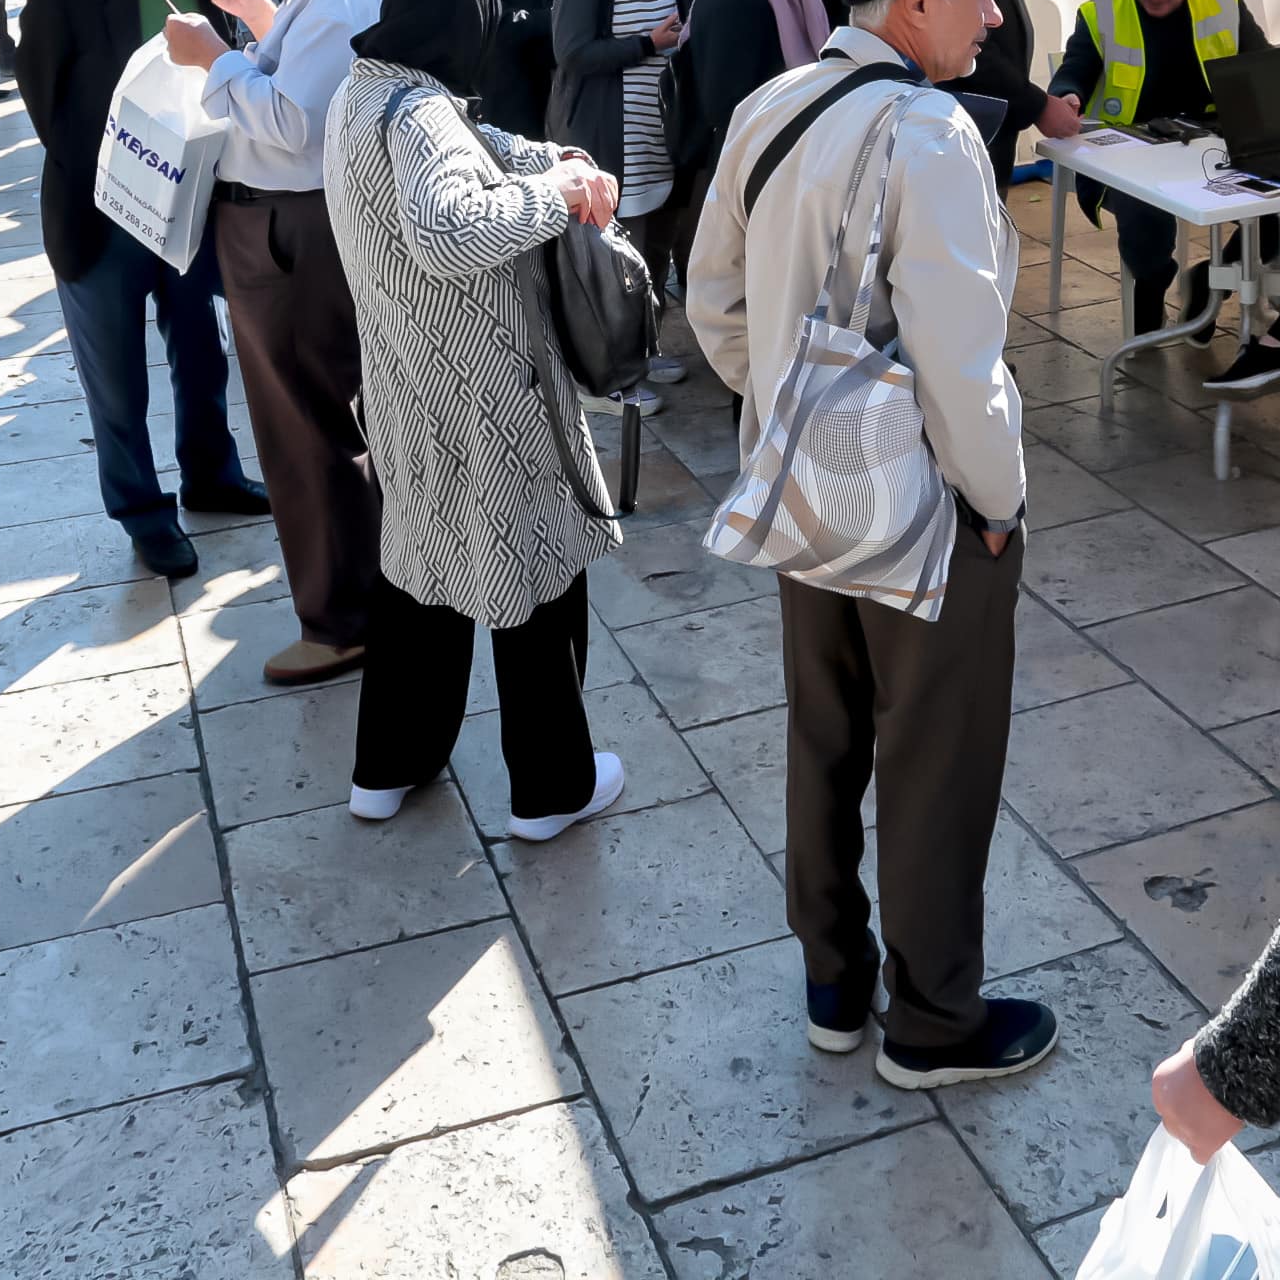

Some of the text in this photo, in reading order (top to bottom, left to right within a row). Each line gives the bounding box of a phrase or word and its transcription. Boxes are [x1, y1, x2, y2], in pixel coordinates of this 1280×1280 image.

[116, 128, 187, 185] KEYSAN
[109, 197, 124, 215] 258
[142, 223, 152, 238] 20
[154, 233, 166, 247] 20
